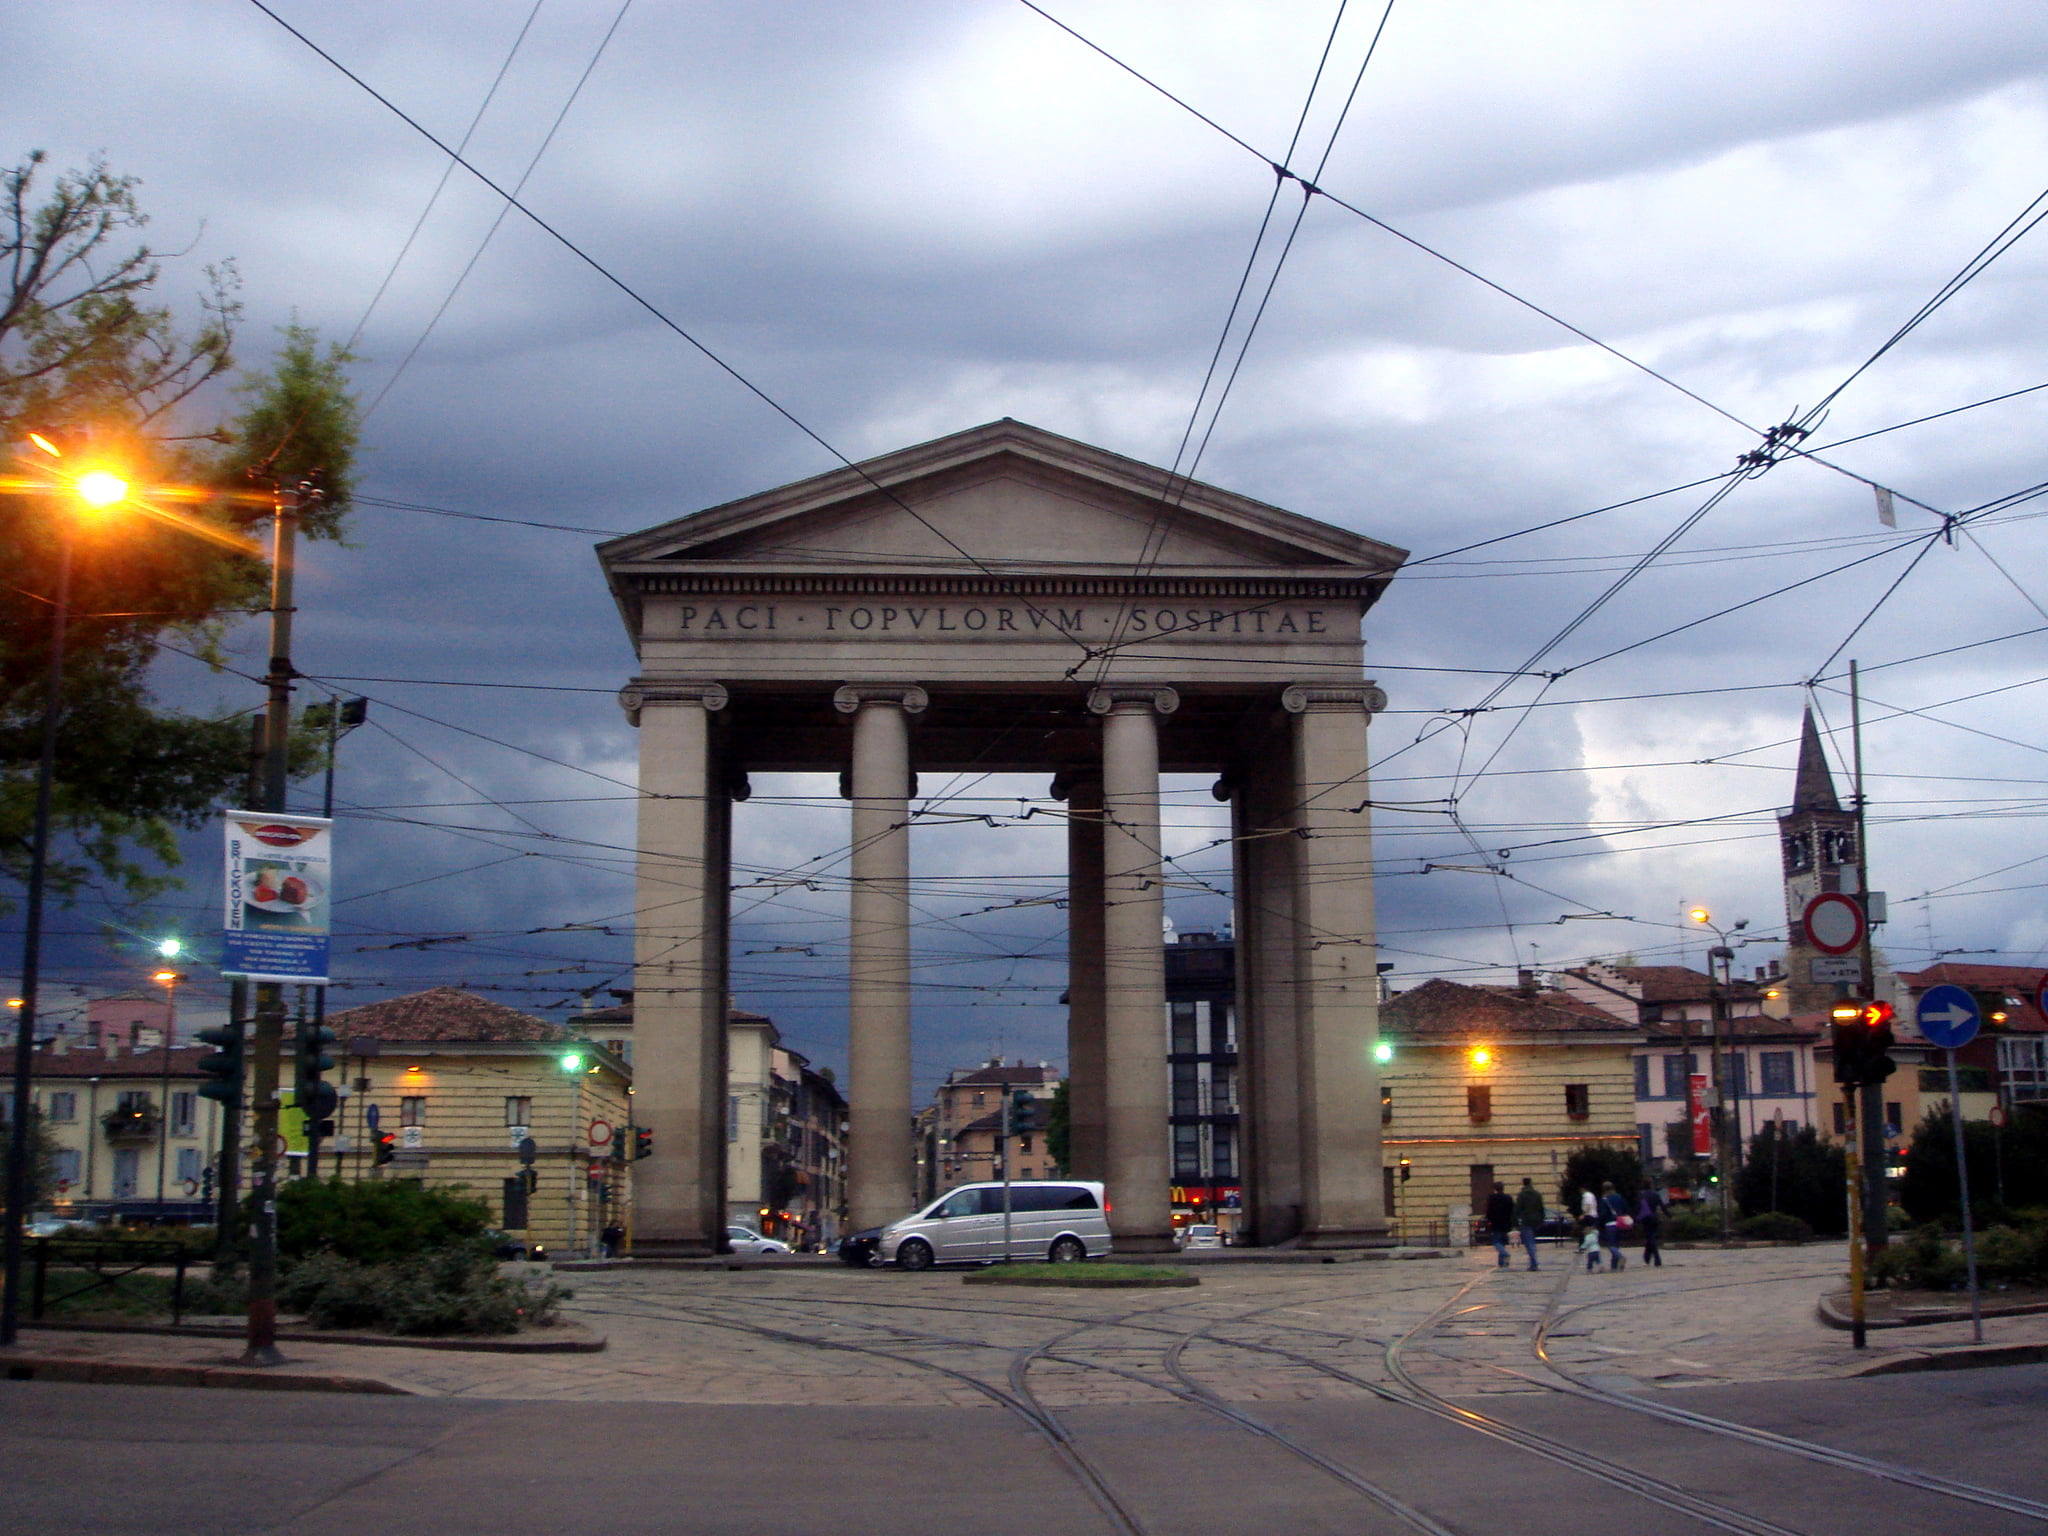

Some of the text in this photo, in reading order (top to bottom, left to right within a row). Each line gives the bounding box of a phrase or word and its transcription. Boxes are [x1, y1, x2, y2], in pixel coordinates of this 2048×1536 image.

[680, 606, 1328, 633] PACI POPVLORVM SOSPITAE
